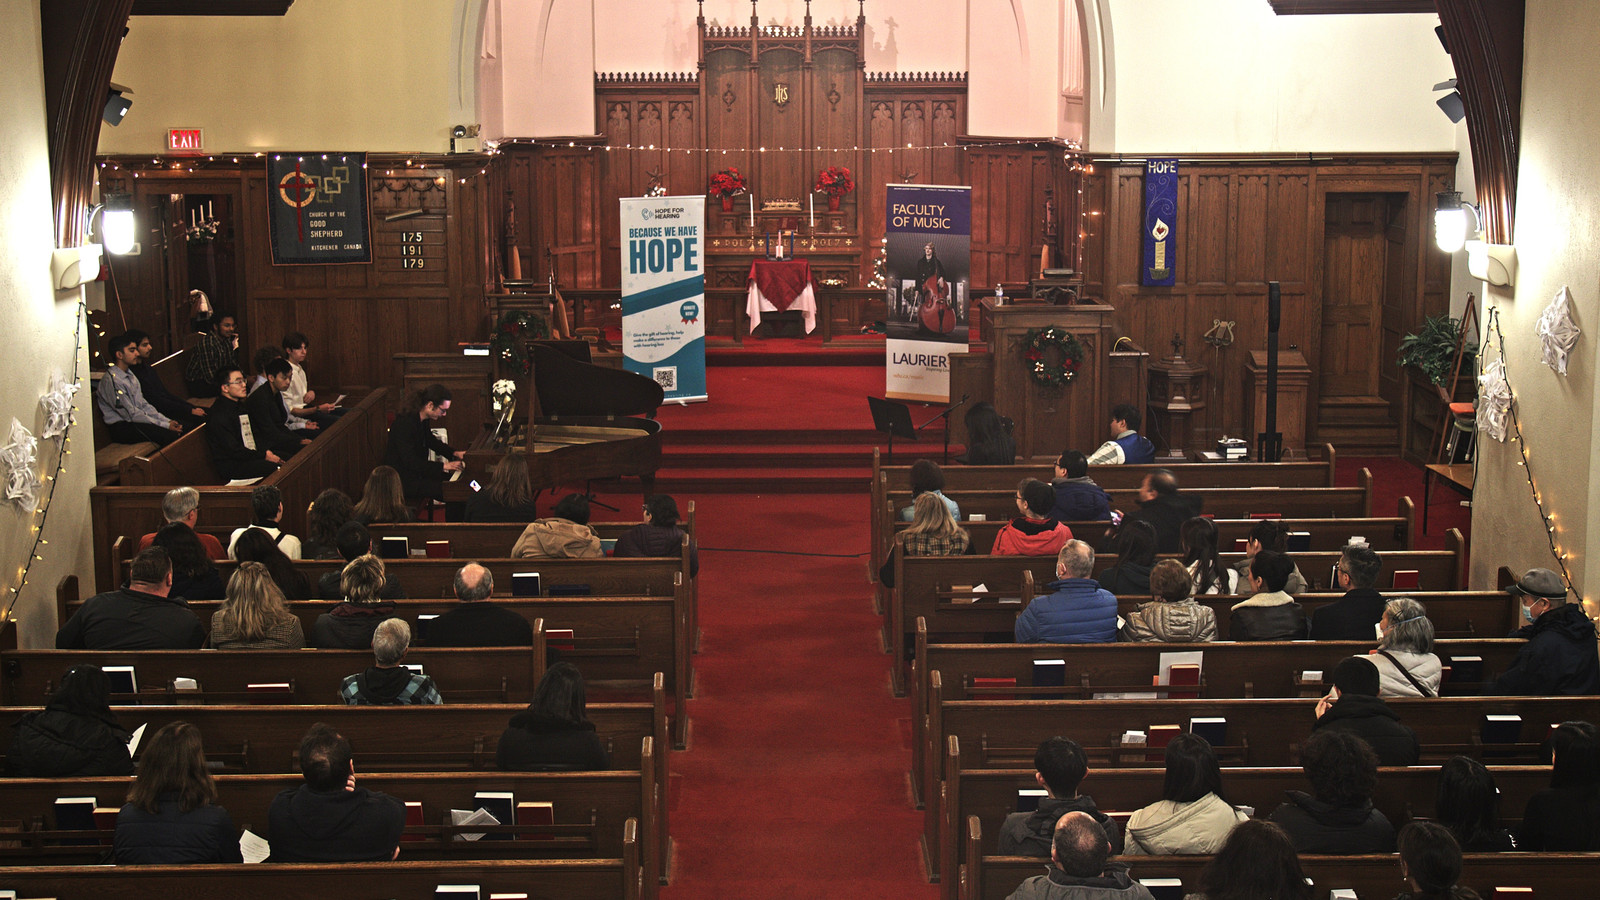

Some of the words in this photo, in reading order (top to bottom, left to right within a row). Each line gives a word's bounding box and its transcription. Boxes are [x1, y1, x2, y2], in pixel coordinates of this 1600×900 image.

[172, 130, 200, 148] EXIT
[1148, 160, 1177, 174] HOPE
[893, 203, 945, 216] FACULTY
[310, 220, 326, 228] GOOD
[892, 216, 910, 228] OF
[913, 217, 951, 229] MUSIC
[310, 230, 343, 238] SHEPHERD
[403, 232, 422, 242] 175
[629, 227, 662, 238] BECAUSE
[664, 226, 676, 237] WE
[678, 226, 697, 236] HAVE
[403, 245, 421, 255] 191
[629, 237, 698, 274] HOPE
[404, 258, 424, 268] 179
[893, 353, 947, 368] LAURIER
